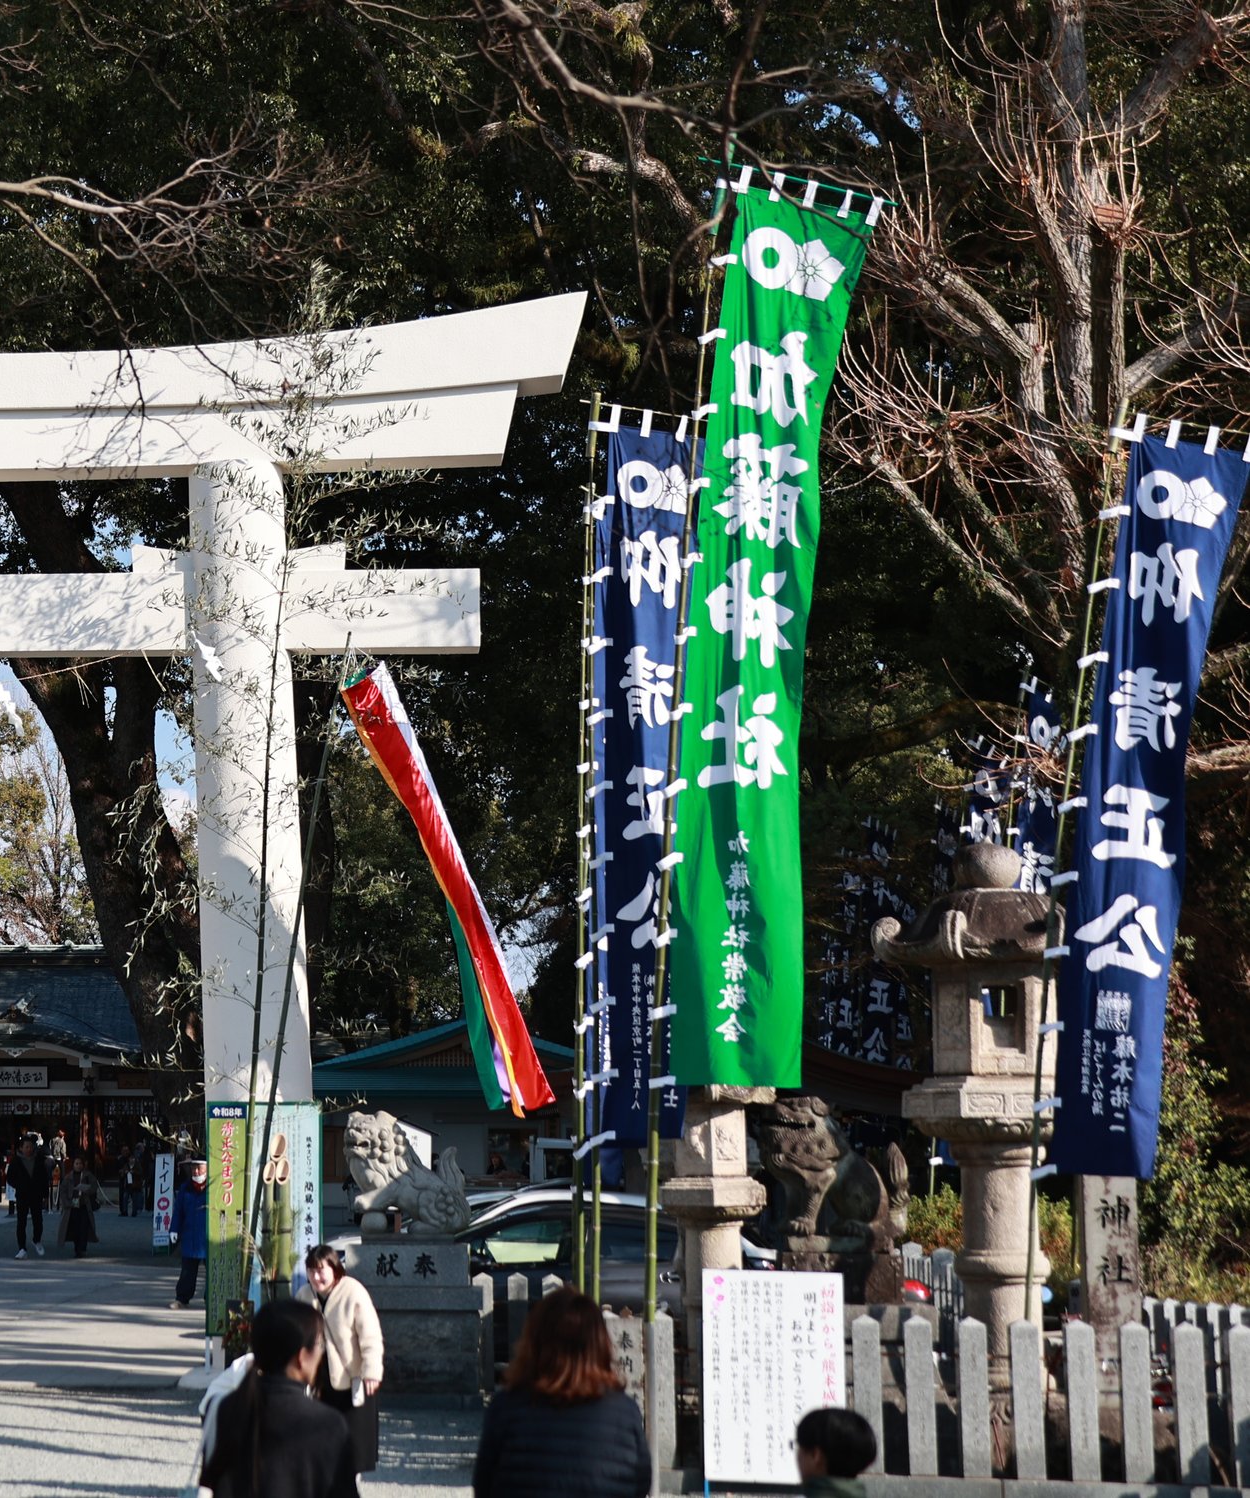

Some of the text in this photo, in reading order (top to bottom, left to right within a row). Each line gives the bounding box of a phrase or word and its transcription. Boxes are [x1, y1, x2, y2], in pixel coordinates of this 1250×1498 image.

[212, 1107, 242, 1117] 令和8年
[159, 1157, 170, 1195] トイレ
[221, 1120, 234, 1206] 清正公まつり
[1094, 1195, 1133, 1286] 神社
[803, 1291, 817, 1361] 明けまして
